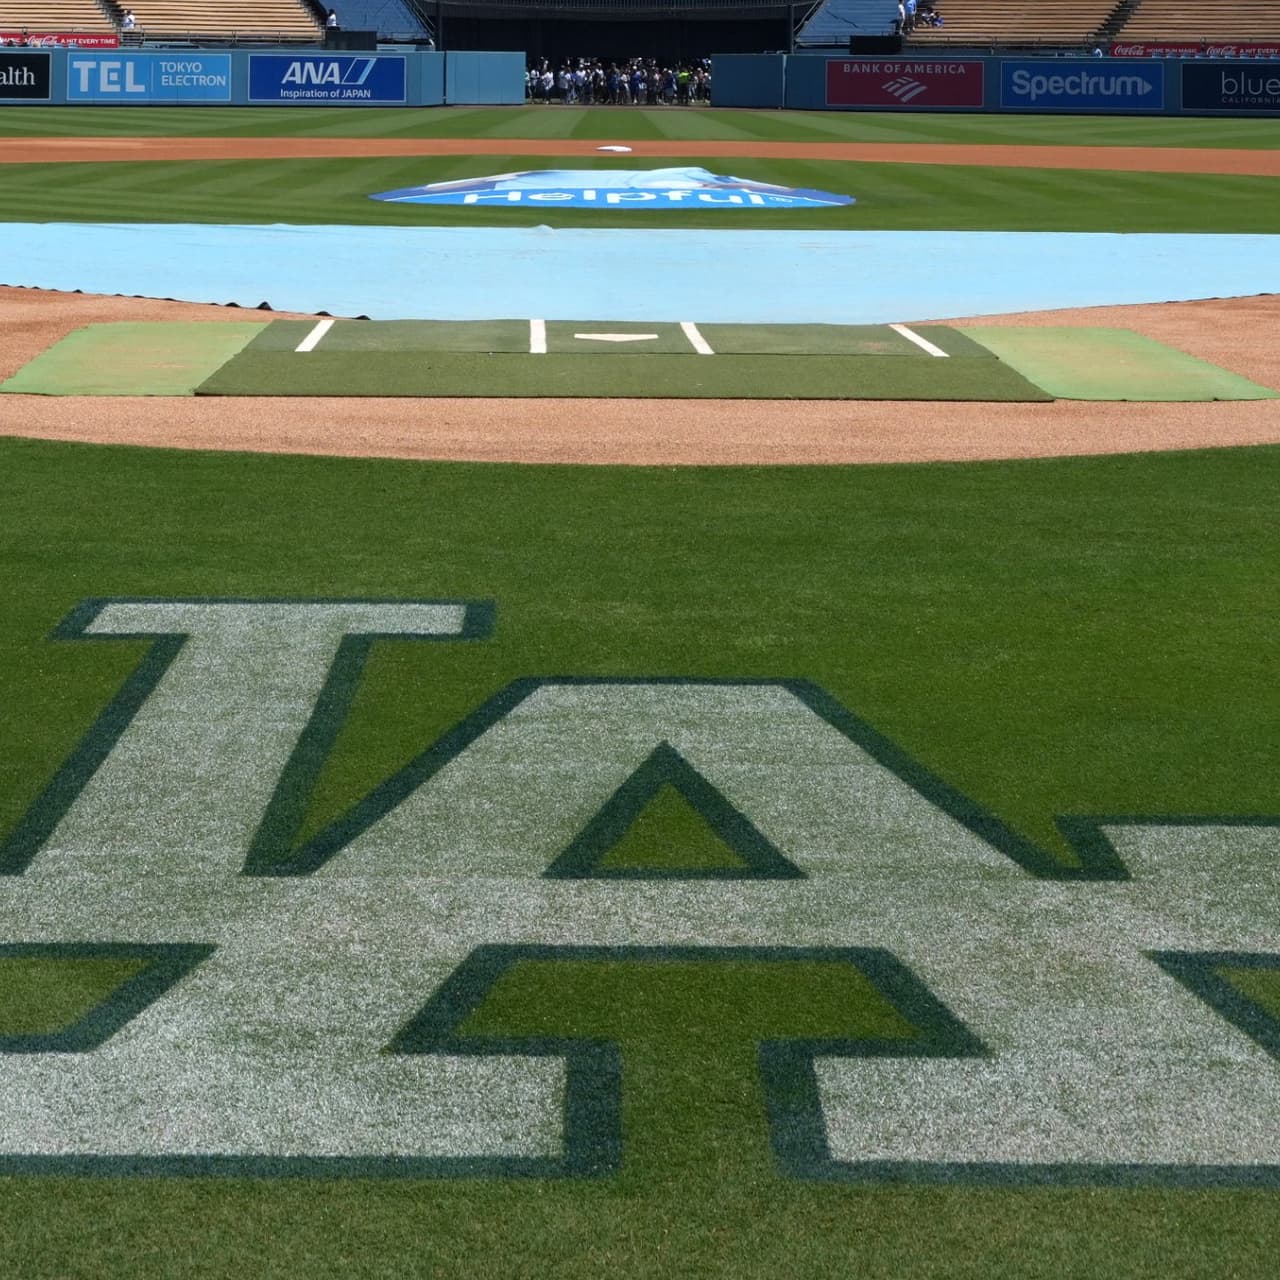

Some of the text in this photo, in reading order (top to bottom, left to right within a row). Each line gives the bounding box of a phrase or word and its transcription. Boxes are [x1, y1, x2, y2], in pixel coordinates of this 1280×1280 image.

[159, 61, 203, 74] TOKYO
[280, 61, 341, 85] ANA
[842, 63, 967, 75] BANK OF AMERICA
[72, 61, 146, 92] TEL
[161, 74, 227, 87] ELECTRON
[1012, 69, 1143, 101] Spectrum
[280, 88, 372, 99] Inspiration of JAPAN
[463, 188, 765, 205] Helpful
